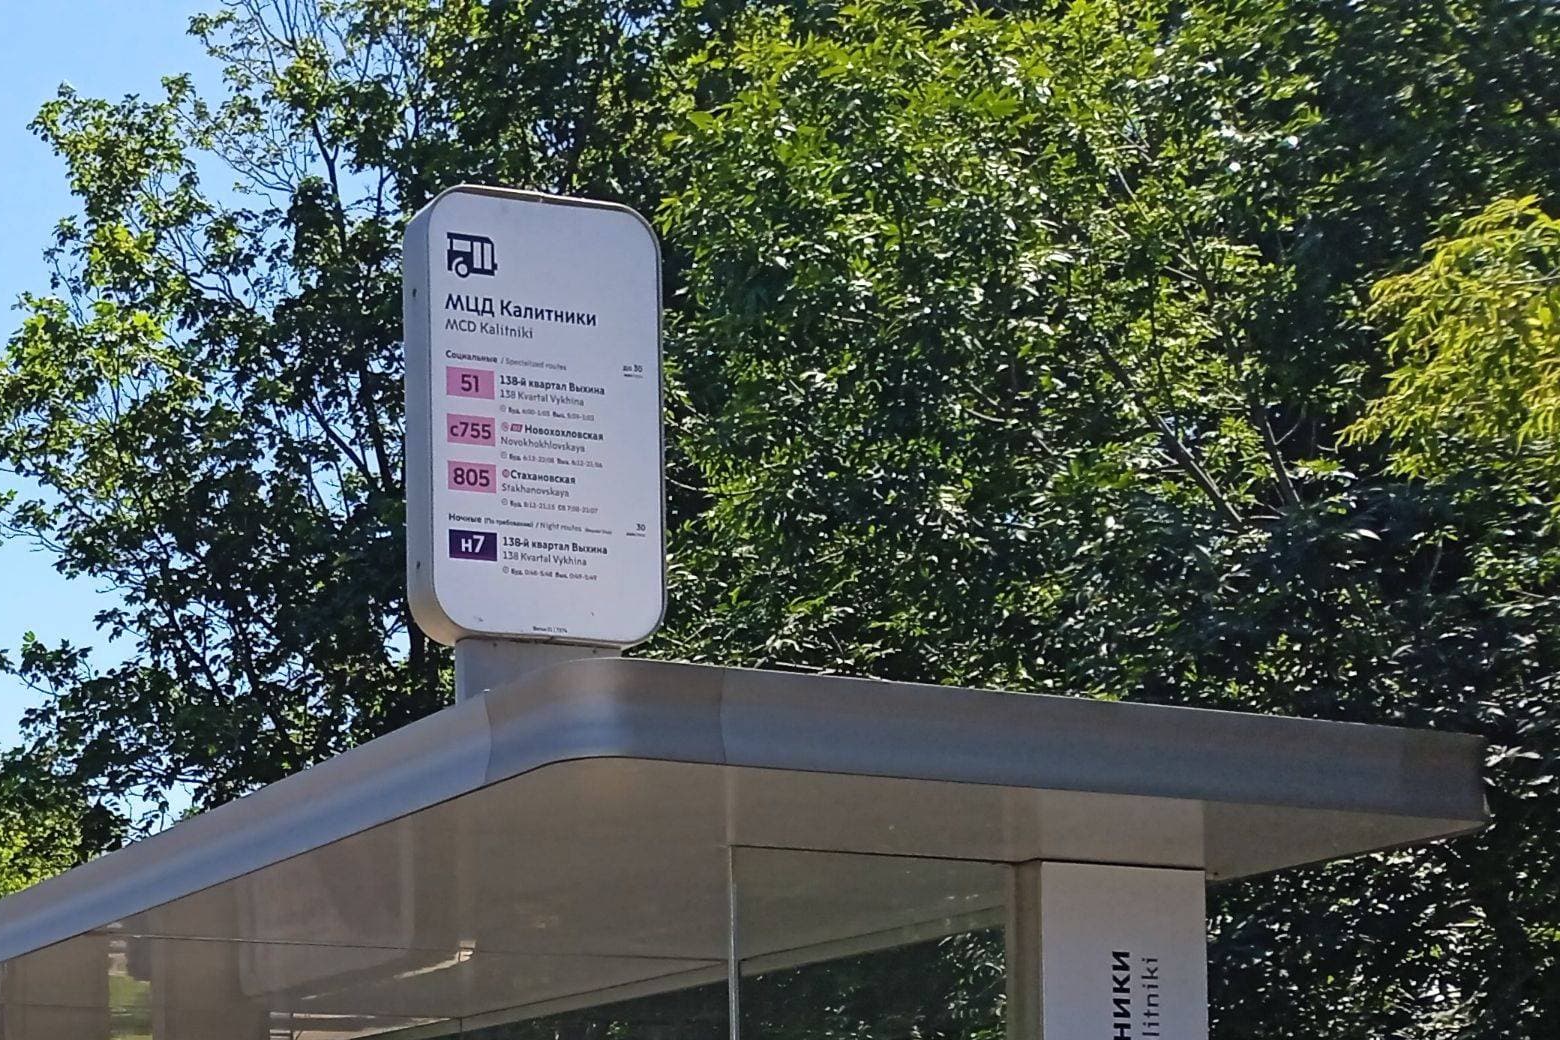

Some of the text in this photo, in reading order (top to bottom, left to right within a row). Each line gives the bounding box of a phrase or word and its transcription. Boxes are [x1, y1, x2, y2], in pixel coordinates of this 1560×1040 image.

[445, 294, 597, 326] МЦД Калитники
[445, 318, 534, 339] MCD Kalitniki
[445, 350, 498, 363] Социальные
[461, 373, 479, 392] 51
[500, 375, 606, 395] 138-й квартал Выхина
[500, 389, 585, 407] 138 Kvartal Vykhina
[450, 422, 492, 440] с755
[524, 424, 604, 441] Новохохловская
[500, 436, 586, 454] Novokhokhlovskaya
[453, 468, 490, 487] 805
[510, 469, 577, 485] Стахановская
[502, 483, 570, 498] Stakhanovskaya
[448, 513, 482, 524] Ночные
[540, 521, 559, 531] Night
[636, 523, 646, 532] 30
[503, 537, 608, 555] 138-й квартал Выхина
[503, 551, 587, 567] 138 Kvartal Vykhina
